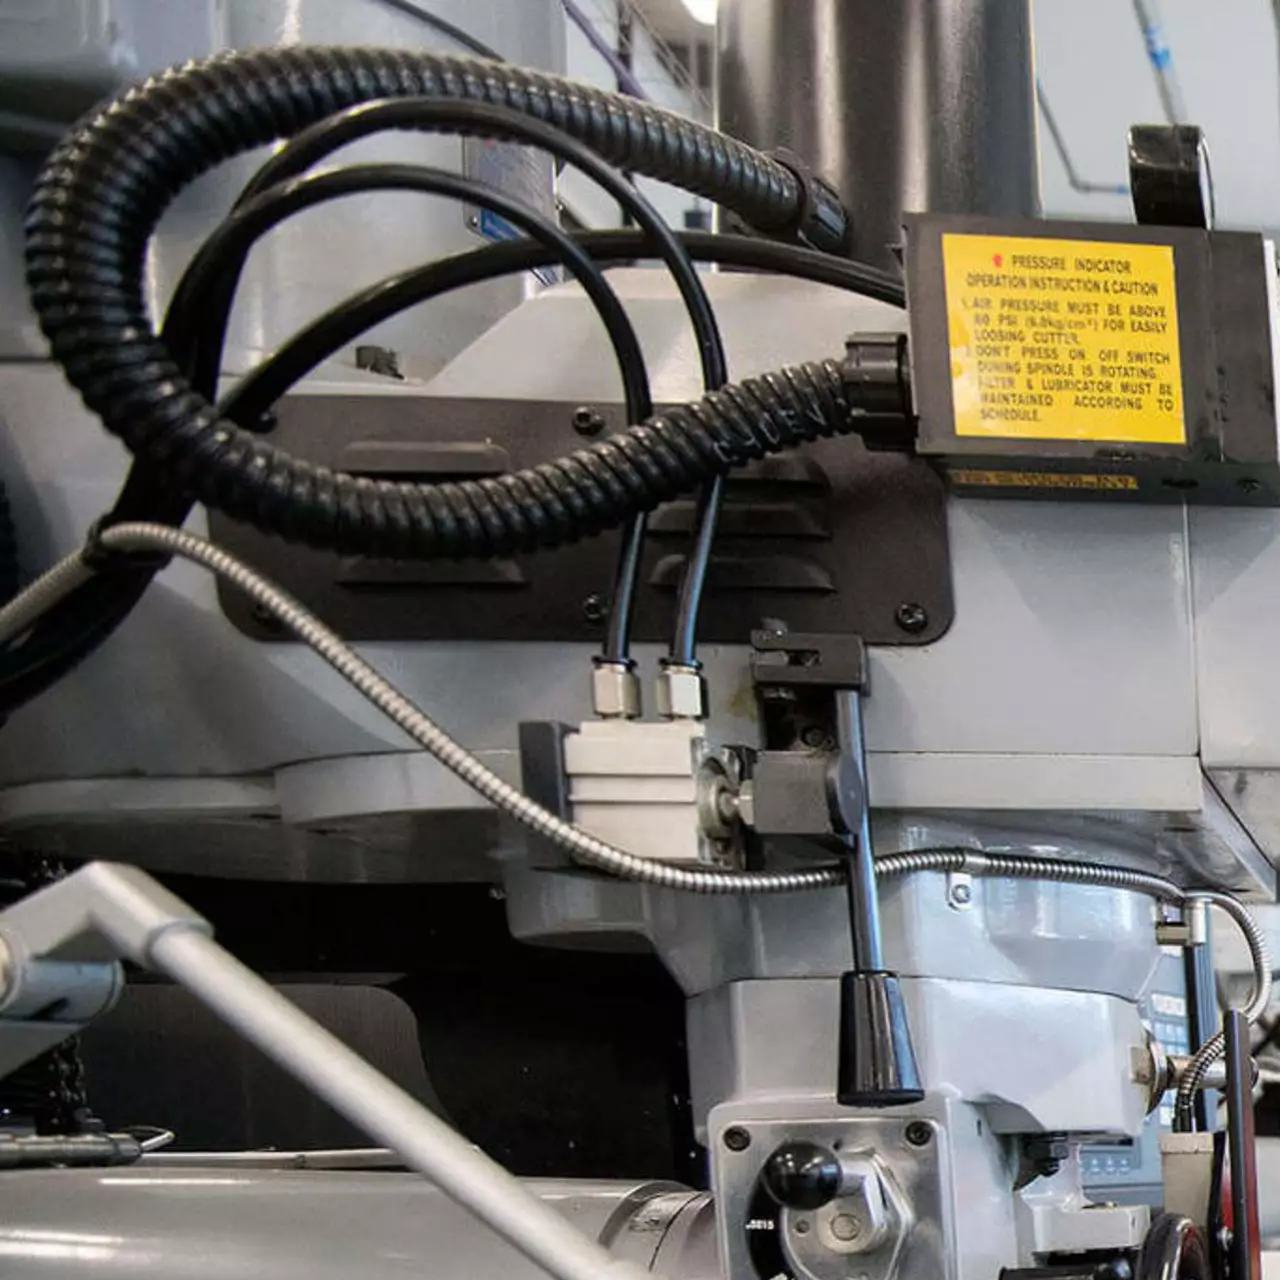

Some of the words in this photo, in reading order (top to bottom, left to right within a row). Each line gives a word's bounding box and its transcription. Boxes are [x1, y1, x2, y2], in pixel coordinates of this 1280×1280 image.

[1012, 255, 1065, 270] PRESSURE
[1075, 258, 1131, 274] INDICATOR
[966, 274, 1027, 289] OPERATION
[1029, 276, 1100, 293] INSTRUCTION
[1112, 281, 1158, 296] CAUTION
[1001, 298, 1060, 313] PRESSURE
[1067, 301, 1099, 316] MUST
[1108, 303, 1121, 317] BE
[1129, 304, 1166, 318] ABOVE
[975, 328, 1026, 342] LOOSING
[1103, 317, 1125, 331] FOR
[1131, 319, 1167, 334] EASILY
[1021, 346, 1059, 360] PRESS
[1069, 347, 1085, 361] ON
[1099, 349, 1119, 363] OFF
[1127, 350, 1170, 365] SWITCH
[1027, 362, 1074, 376] SPINDLE
[1082, 364, 1094, 377] IS
[1042, 379, 1114, 394] LUBRICATOR
[1120, 381, 1151, 396] MUST
[1159, 384, 1173, 397] BE
[980, 392, 1054, 407] MAINTAINED
[1074, 395, 1143, 410] ACCORDING
[1156, 398, 1174, 412] TO
